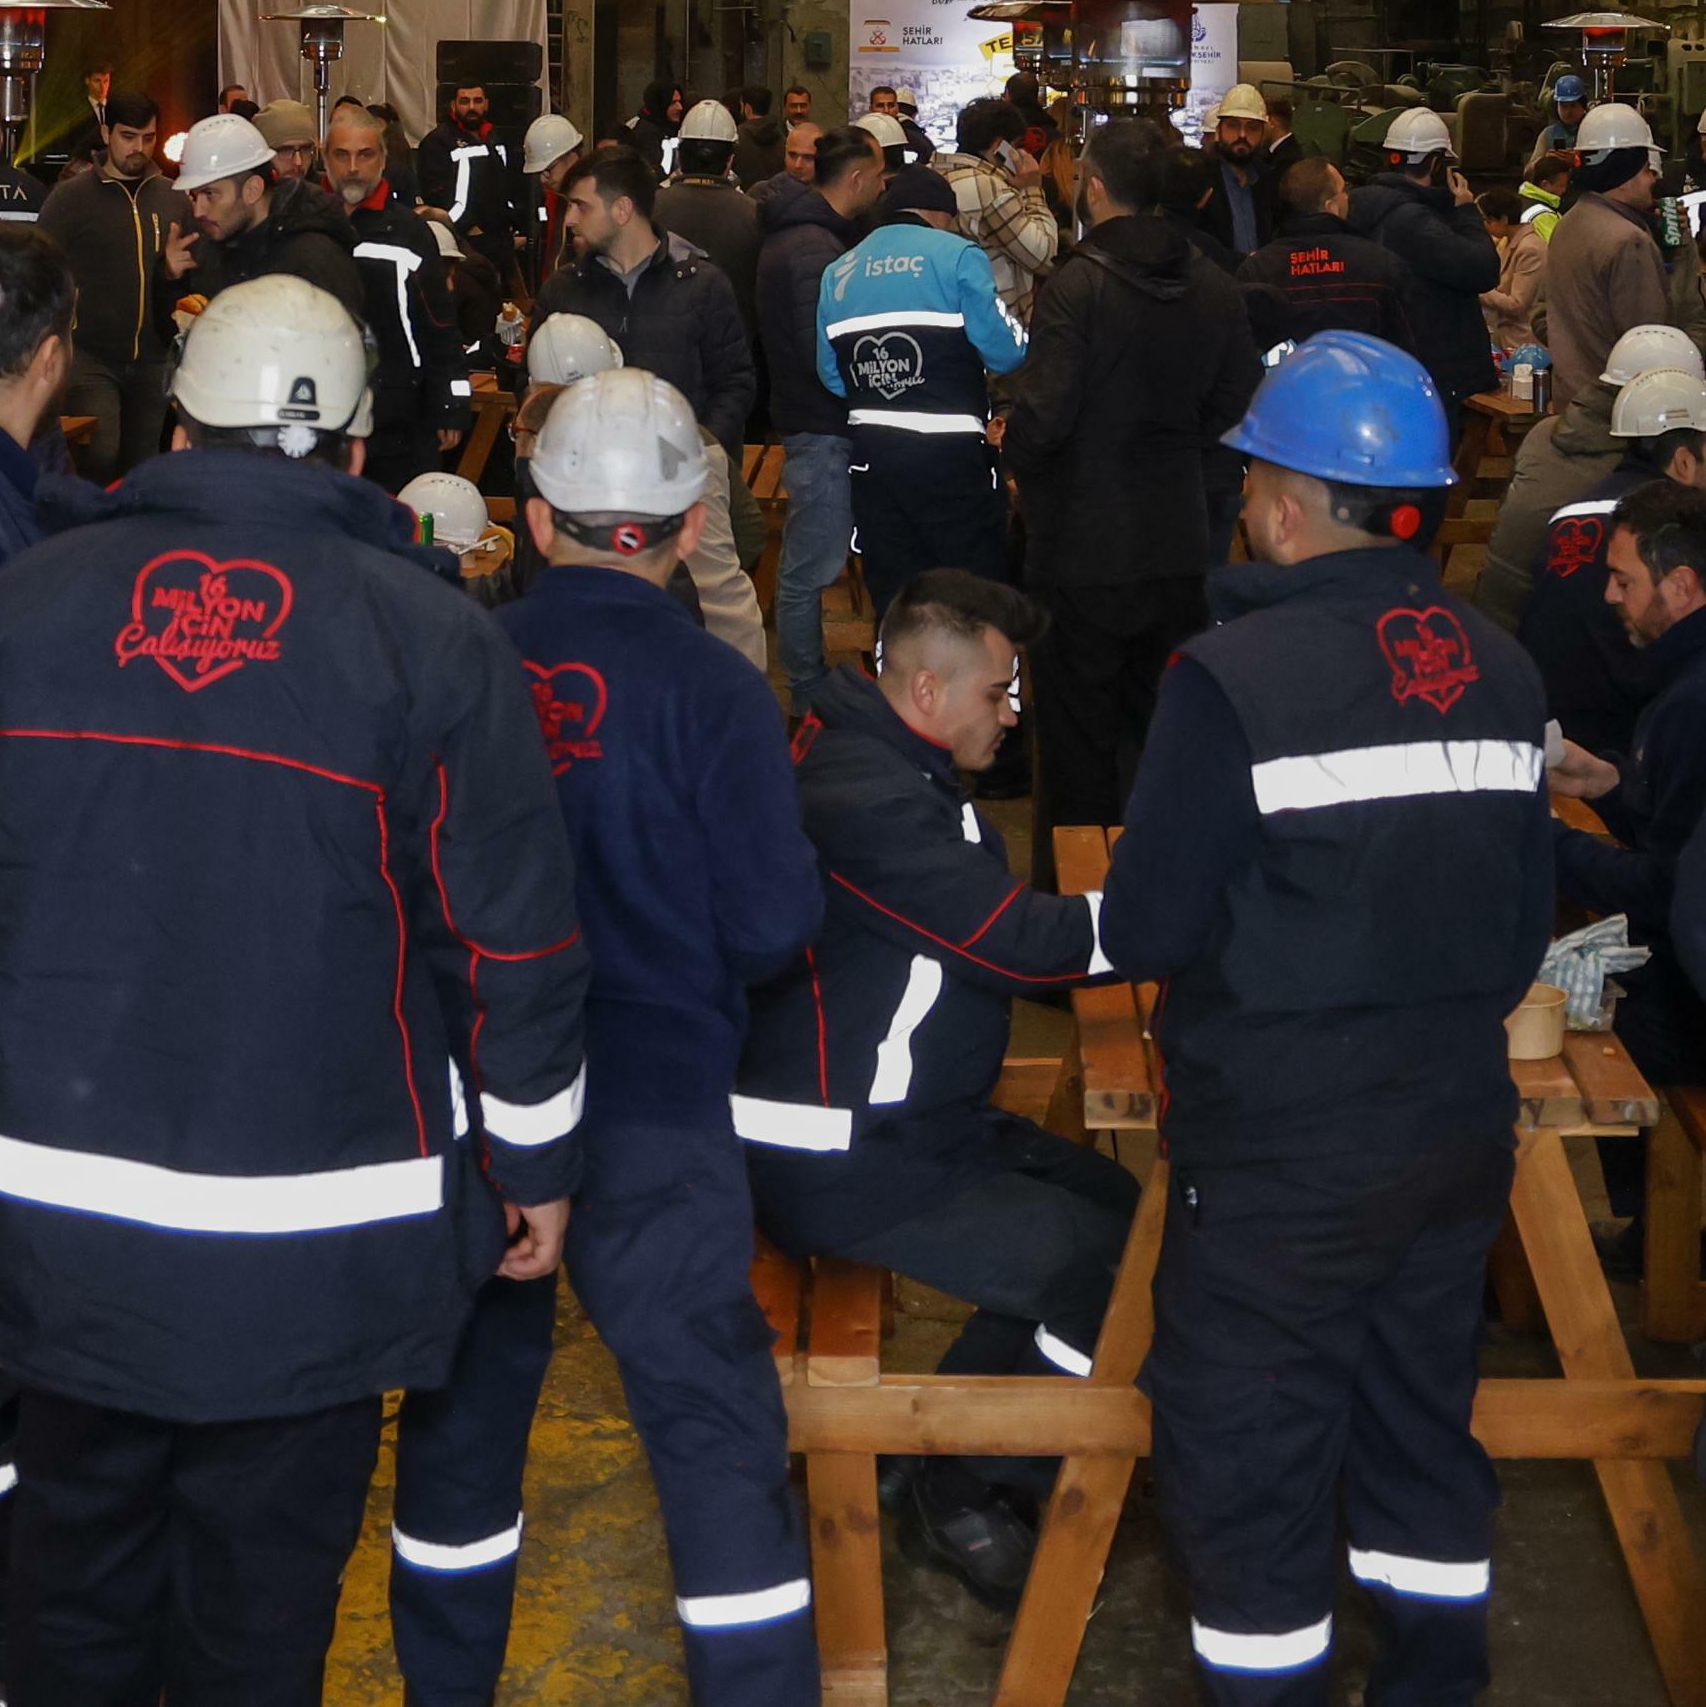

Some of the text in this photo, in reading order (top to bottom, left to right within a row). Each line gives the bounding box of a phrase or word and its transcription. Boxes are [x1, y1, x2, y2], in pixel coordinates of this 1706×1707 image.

[902, 24, 932, 36] ŞEHİR
[902, 36, 943, 45] HATLARI
[864, 254, 925, 278] istaç
[1290, 261, 1346, 276] HATLARI
[872, 346, 889, 360] 16
[199, 573, 228, 598] 16
